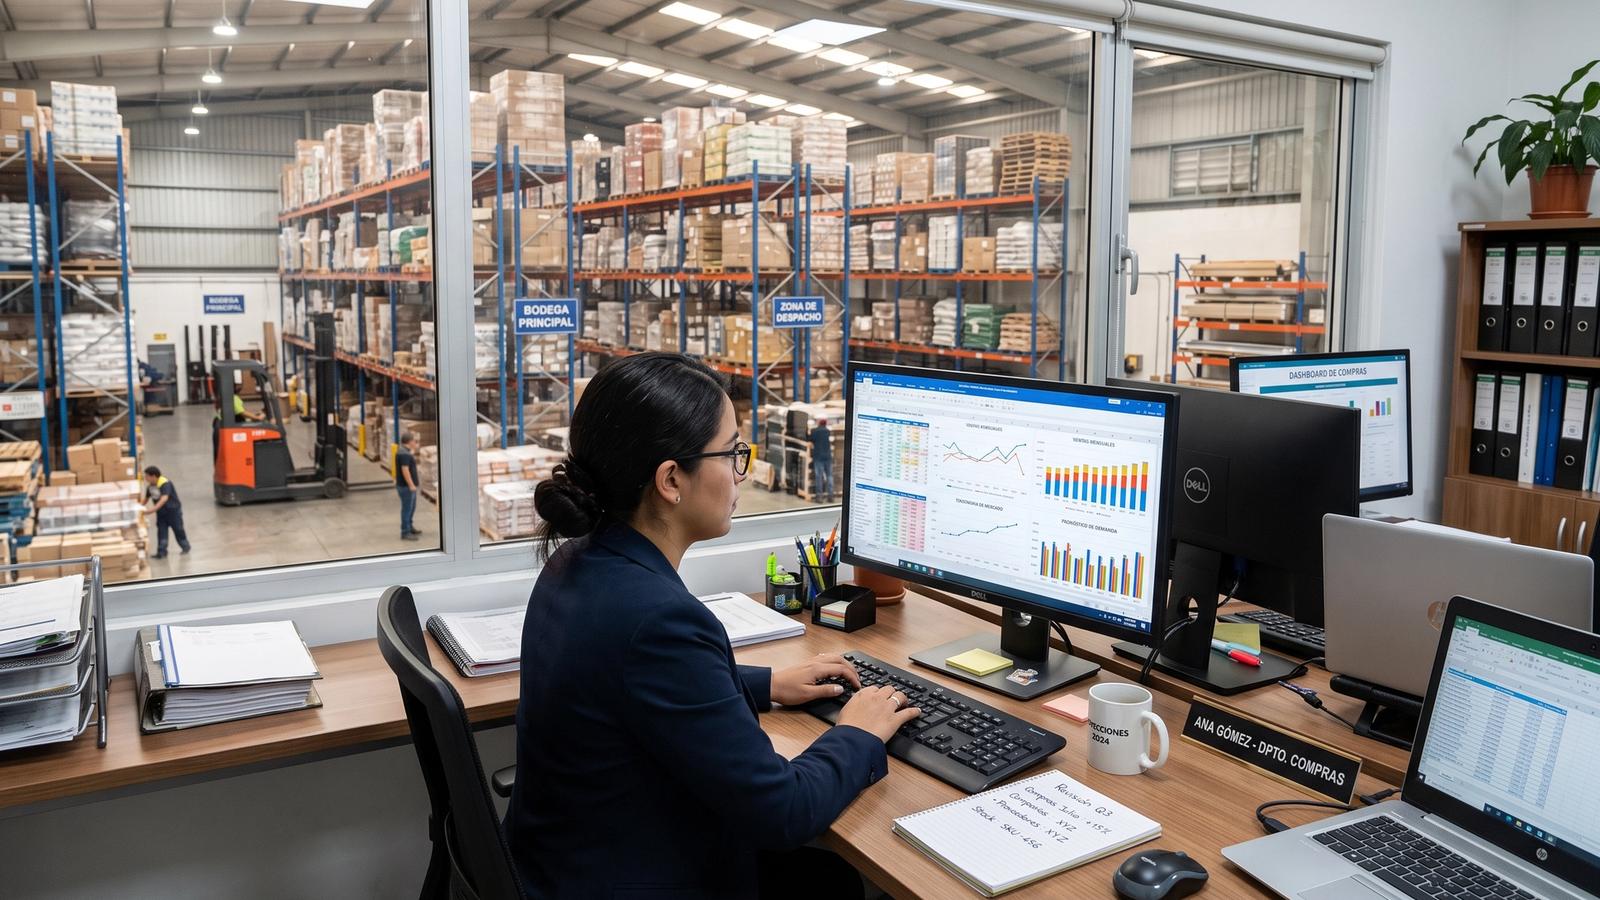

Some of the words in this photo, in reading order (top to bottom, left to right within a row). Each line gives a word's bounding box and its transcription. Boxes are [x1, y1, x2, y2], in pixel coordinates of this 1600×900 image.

[523, 304, 570, 315] BODEGA
[780, 301, 804, 311] ZONA
[805, 301, 817, 311] DE
[518, 317, 574, 328] PRINCIPAL
[776, 312, 822, 323] DESPACHO
[1289, 369, 1328, 380] DASHBOARD
[1328, 369, 1337, 377] DE
[1337, 367, 1368, 377] COMPRAS
[1186, 478, 1207, 492] DELL
[971, 590, 987, 601] DELL
[1092, 732, 1109, 745] 2024
[1193, 715, 1214, 734] ANA
[1216, 724, 1252, 749] GÓMEZ
[1258, 740, 1287, 764] DPTO.
[1290, 753, 1345, 786] COMPRAS
[1025, 786, 1057, 807] Compras
[1054, 783, 1092, 807] Revisión
[1095, 806, 1113, 817] Q3
[971, 806, 996, 822] Stock
[1056, 819, 1077, 832] XYZ
[1045, 828, 1069, 844] XYZ
[1536, 848, 1547, 860] hp
